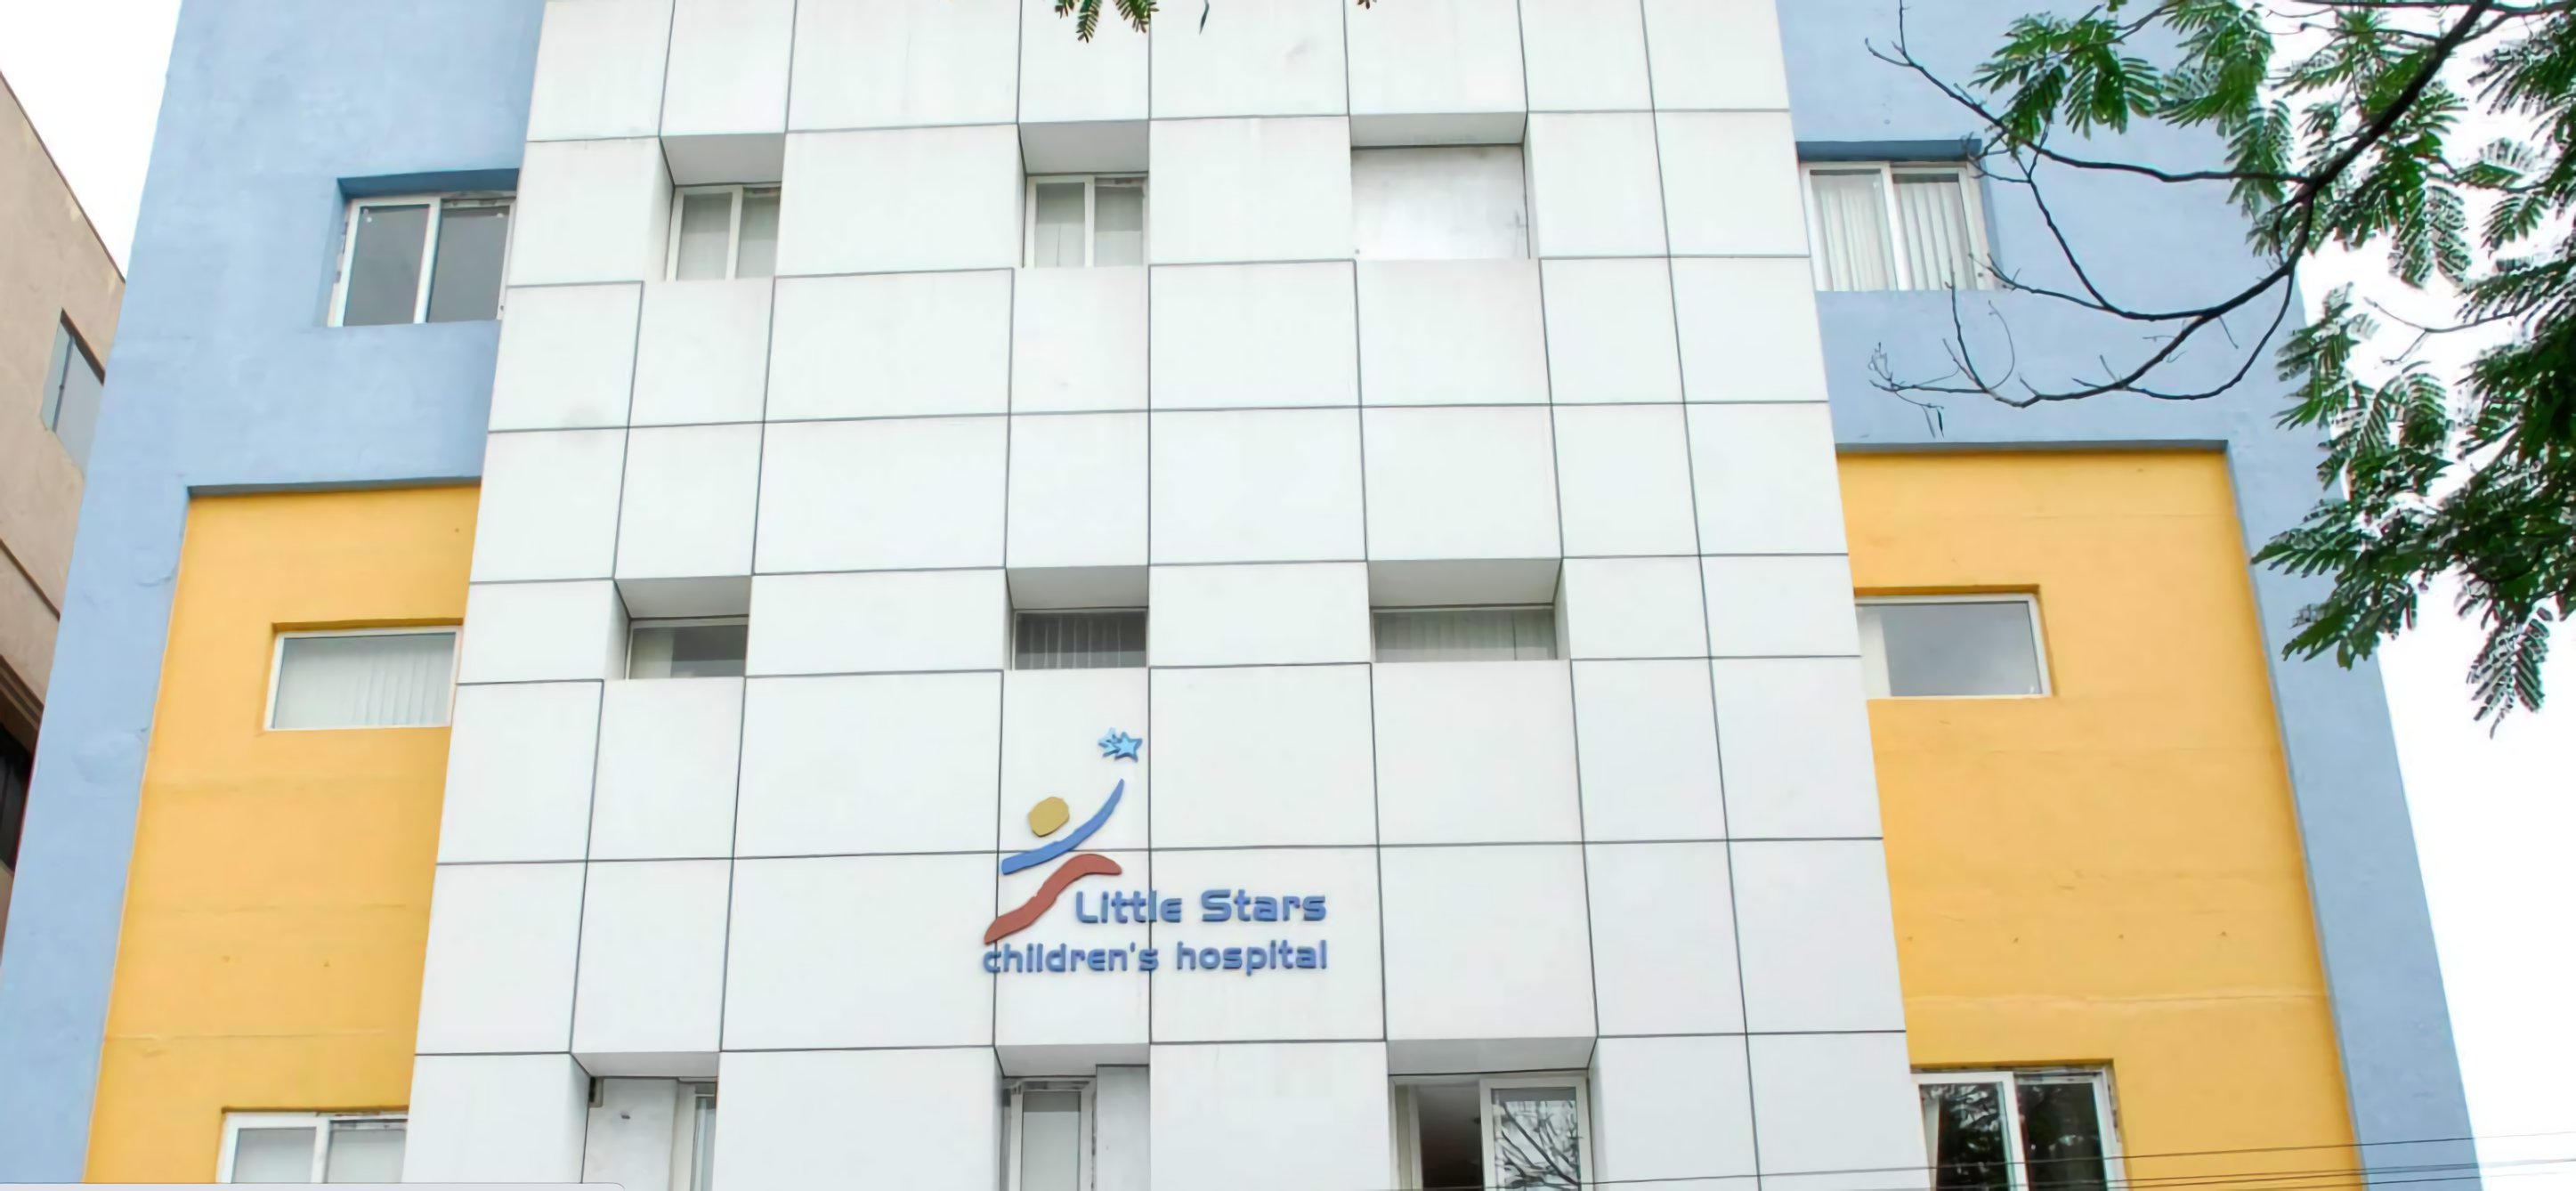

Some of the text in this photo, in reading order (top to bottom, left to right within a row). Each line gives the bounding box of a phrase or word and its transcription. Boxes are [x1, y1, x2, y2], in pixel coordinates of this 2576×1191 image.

[1075, 888, 1327, 924] Little Stars
[982, 939, 1328, 976] children's hospital
